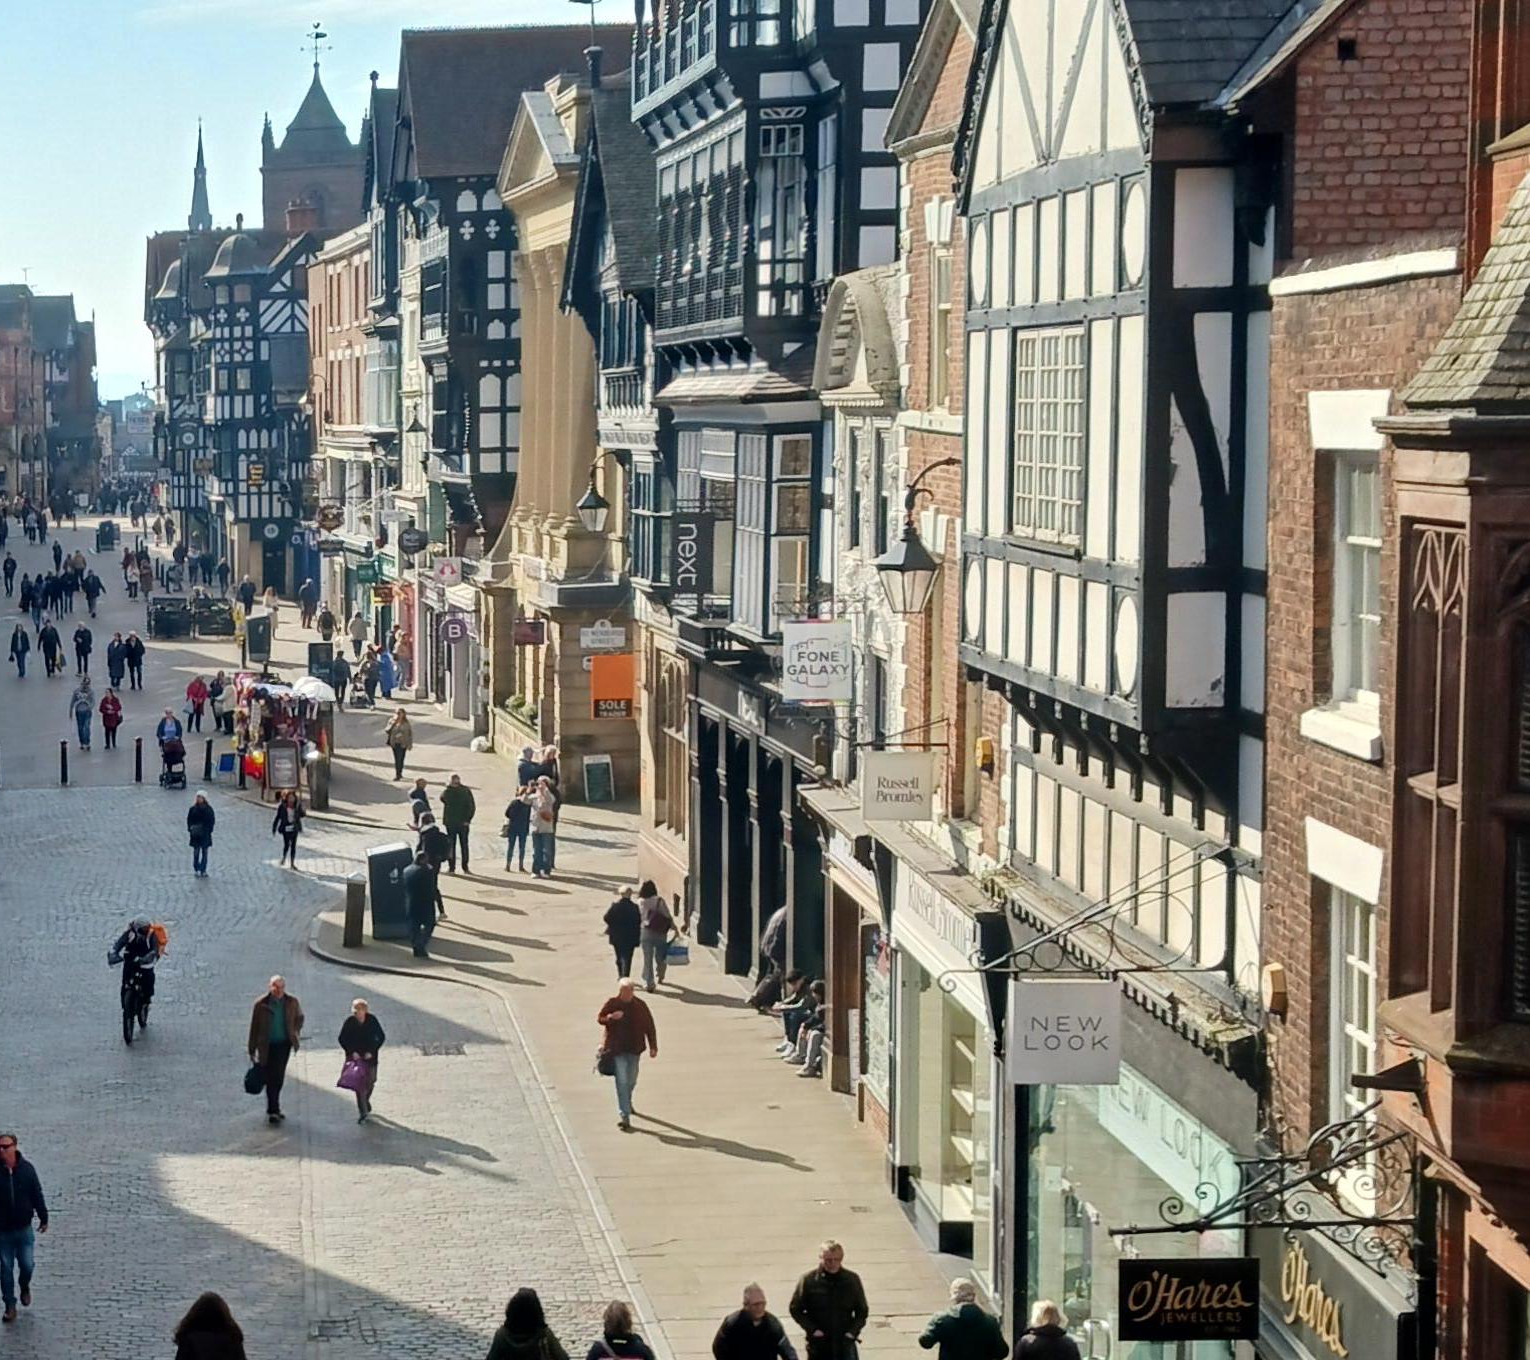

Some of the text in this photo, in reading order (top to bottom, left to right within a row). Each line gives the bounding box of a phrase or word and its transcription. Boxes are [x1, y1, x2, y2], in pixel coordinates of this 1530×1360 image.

[677, 523, 698, 586] next
[797, 651, 840, 662] FONE
[786, 665, 849, 676] GALAXY
[598, 700, 626, 710] SOLE
[877, 776, 919, 789] Russell
[875, 790, 923, 803] Bromley
[1031, 1016, 1102, 1032] NEW
[1024, 1035, 1109, 1050] LOOK
[1161, 1103, 1223, 1186] LOOK
[1128, 1270, 1255, 1322] O'Hares
[1281, 1240, 1349, 1359] O'Hares
[1160, 1311, 1242, 1325] JEWELLERS
